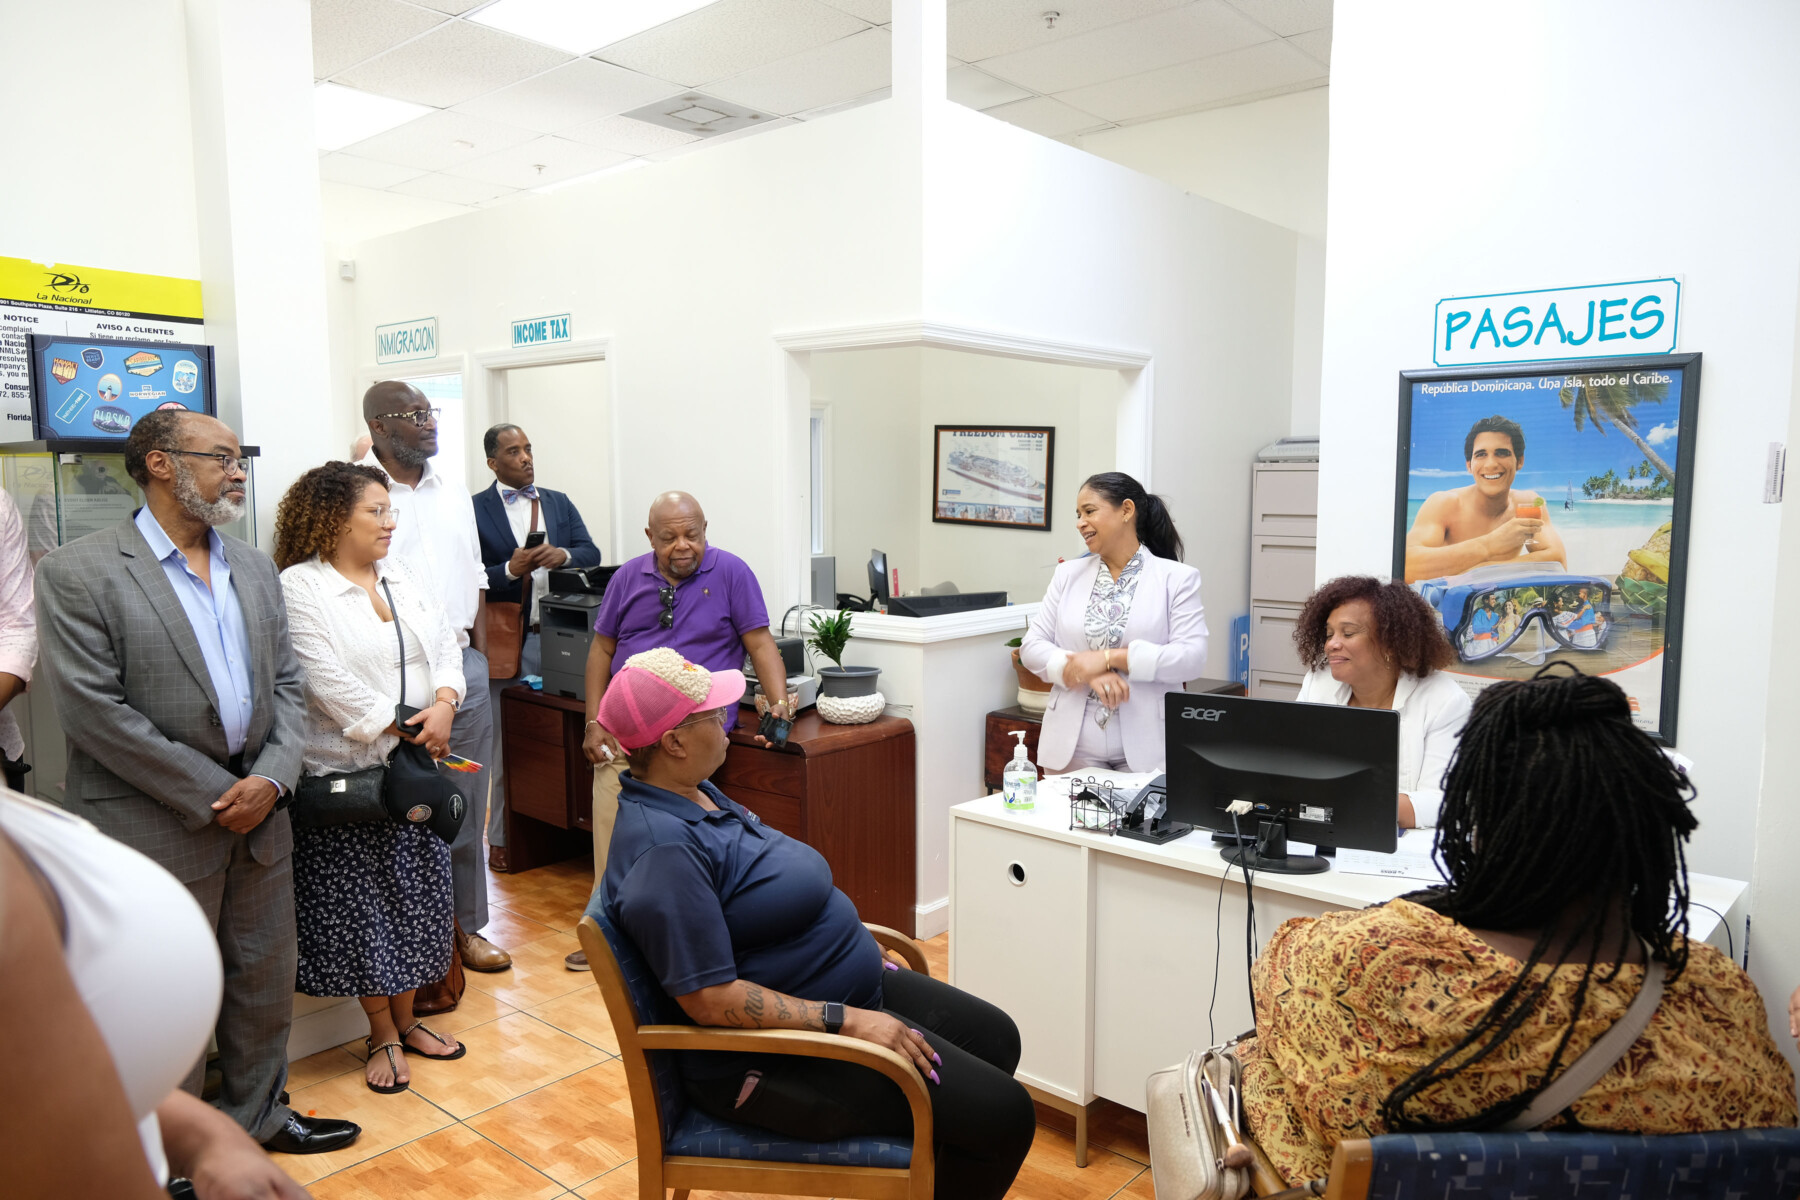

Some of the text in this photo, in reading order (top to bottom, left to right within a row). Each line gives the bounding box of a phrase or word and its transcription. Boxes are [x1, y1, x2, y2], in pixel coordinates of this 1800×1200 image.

[36, 292, 92, 305] La Nacional
[4, 314, 39, 323] NOTICE
[1445, 295, 1665, 351] PASAJES
[96, 323, 123, 331] AVISO
[133, 326, 175, 336] CLIENTES
[513, 318, 569, 344] INCOME TAX
[378, 326, 434, 356] INMIGRACION
[1421, 372, 1673, 397] República Dominicana. Una isla, todo el Caribe.
[7, 413, 32, 421] Florida
[93, 409, 131, 426] ALASKA
[1181, 706, 1227, 722] acer
